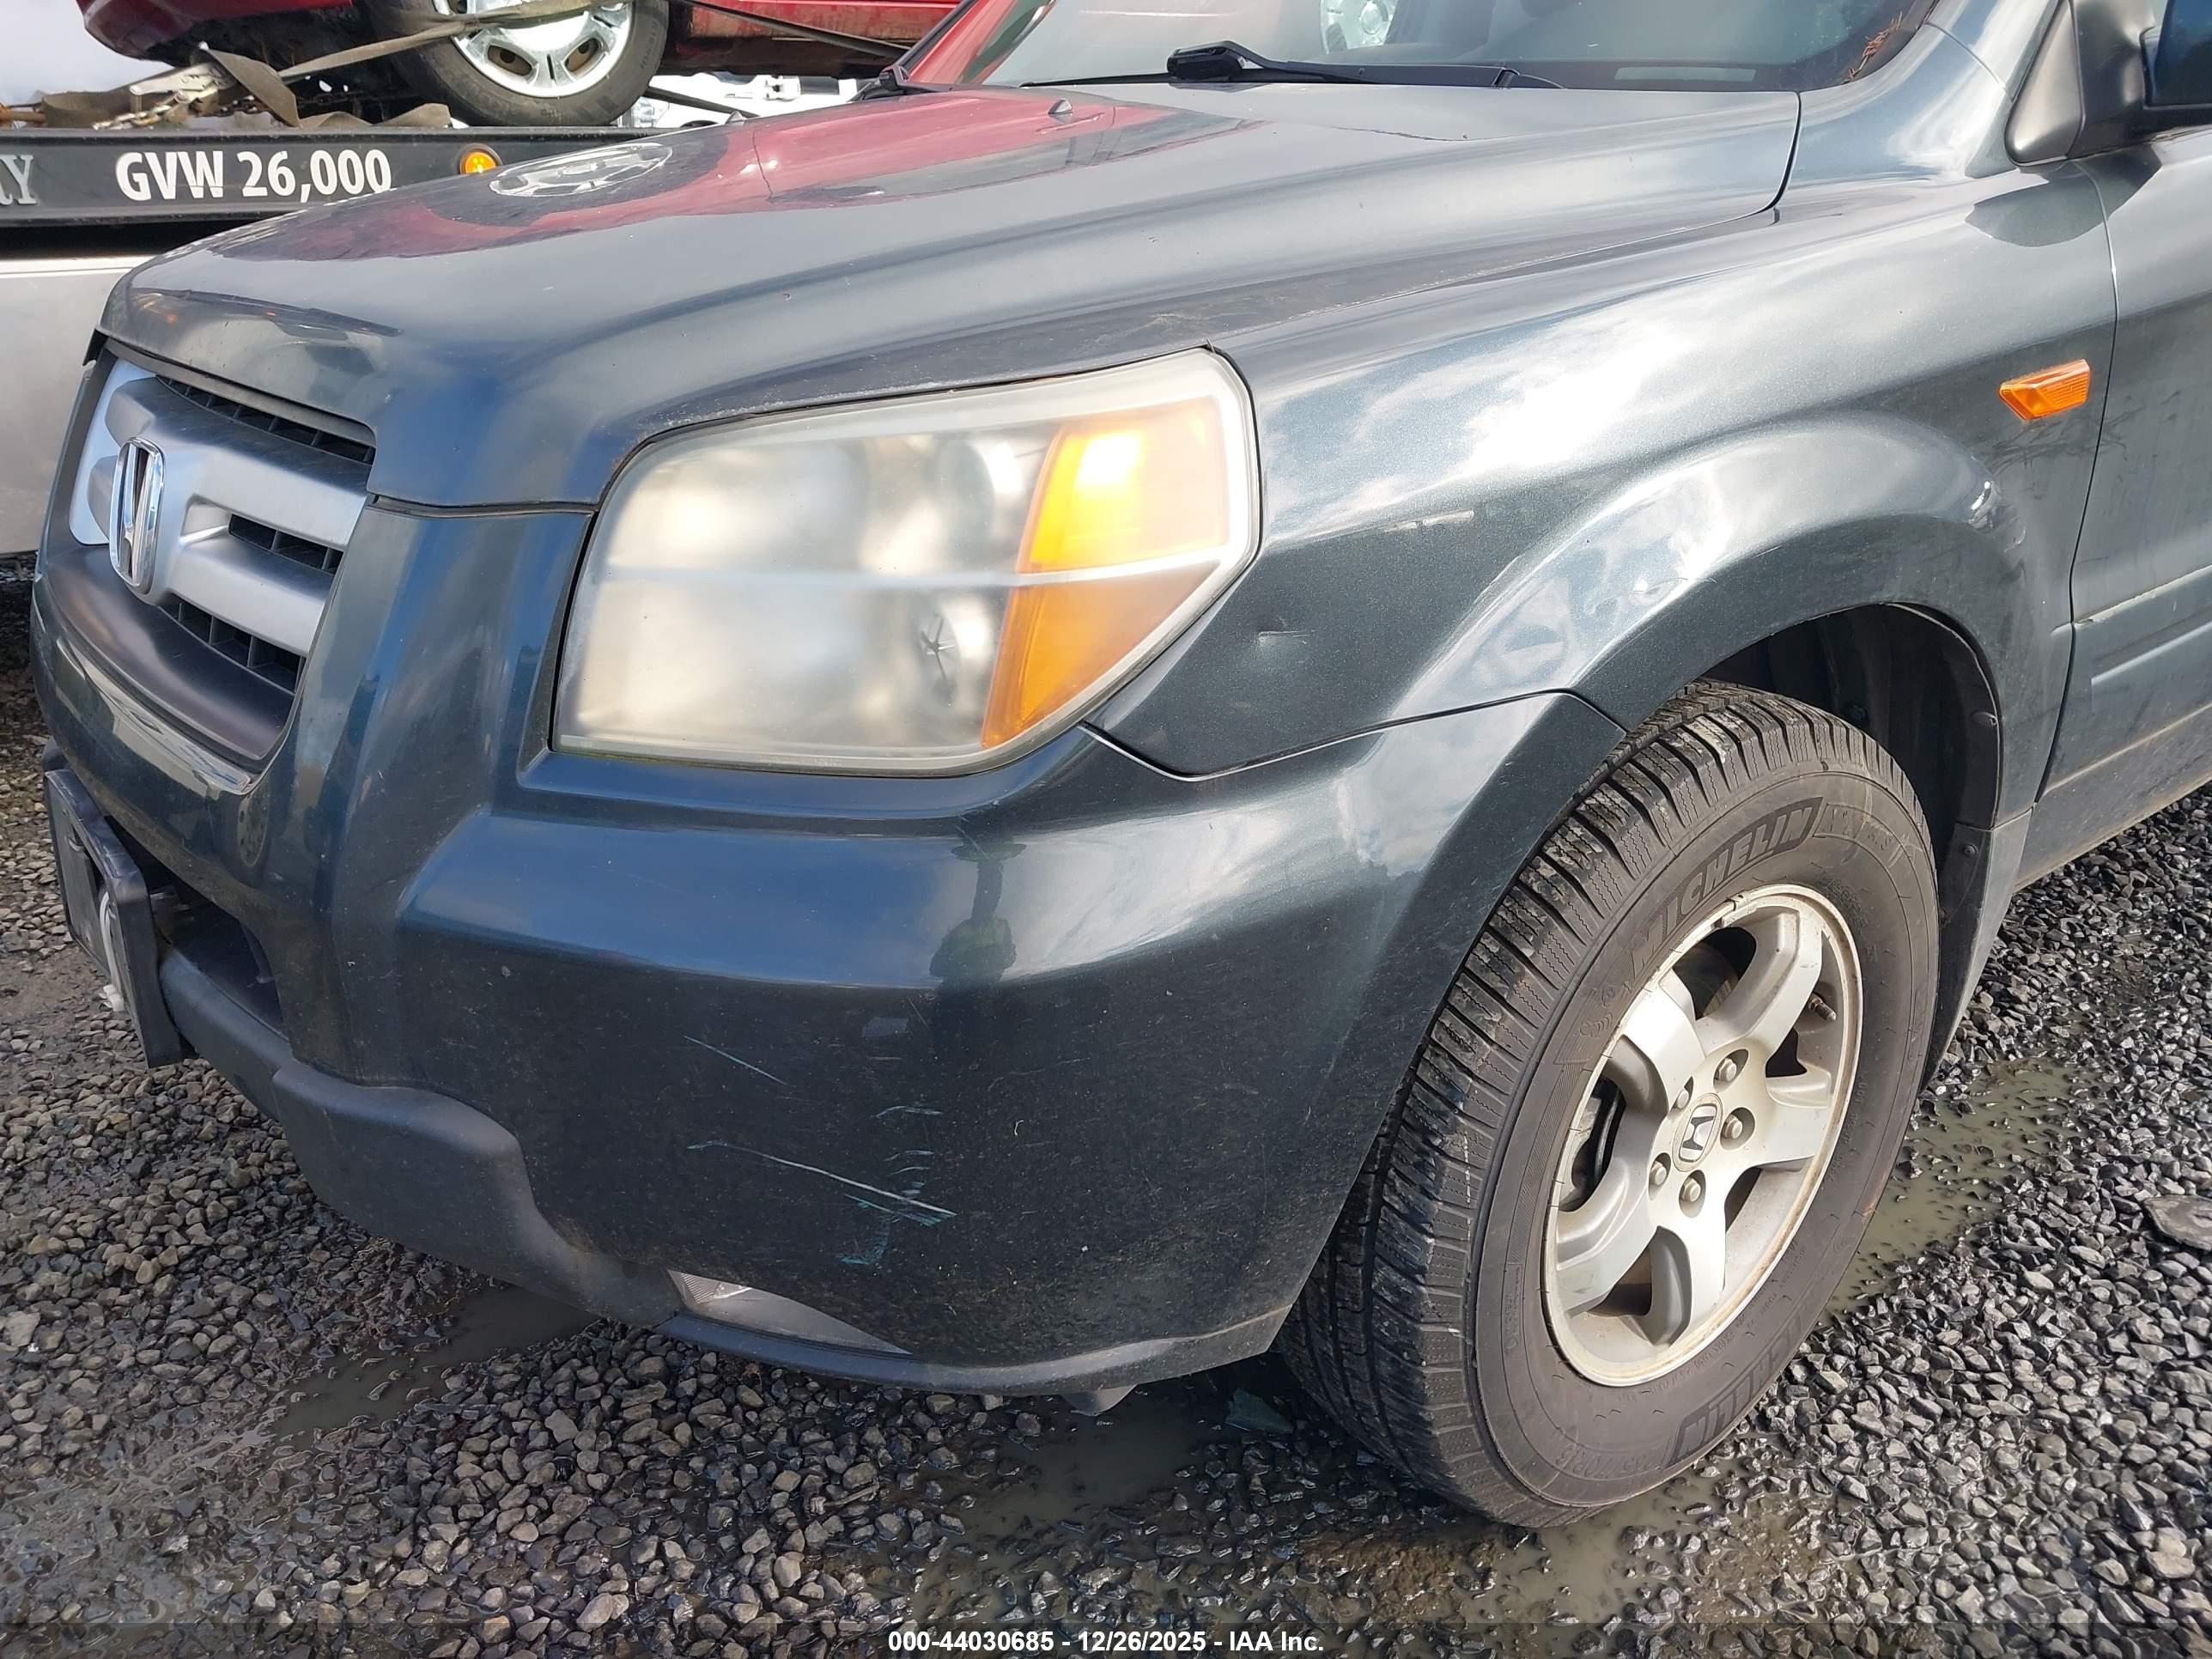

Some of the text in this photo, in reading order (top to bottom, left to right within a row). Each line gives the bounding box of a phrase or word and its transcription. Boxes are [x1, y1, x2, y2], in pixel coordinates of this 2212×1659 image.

[115, 149, 392, 204] GVW 26,000
[1632, 806, 1814, 980] MICHELIN
